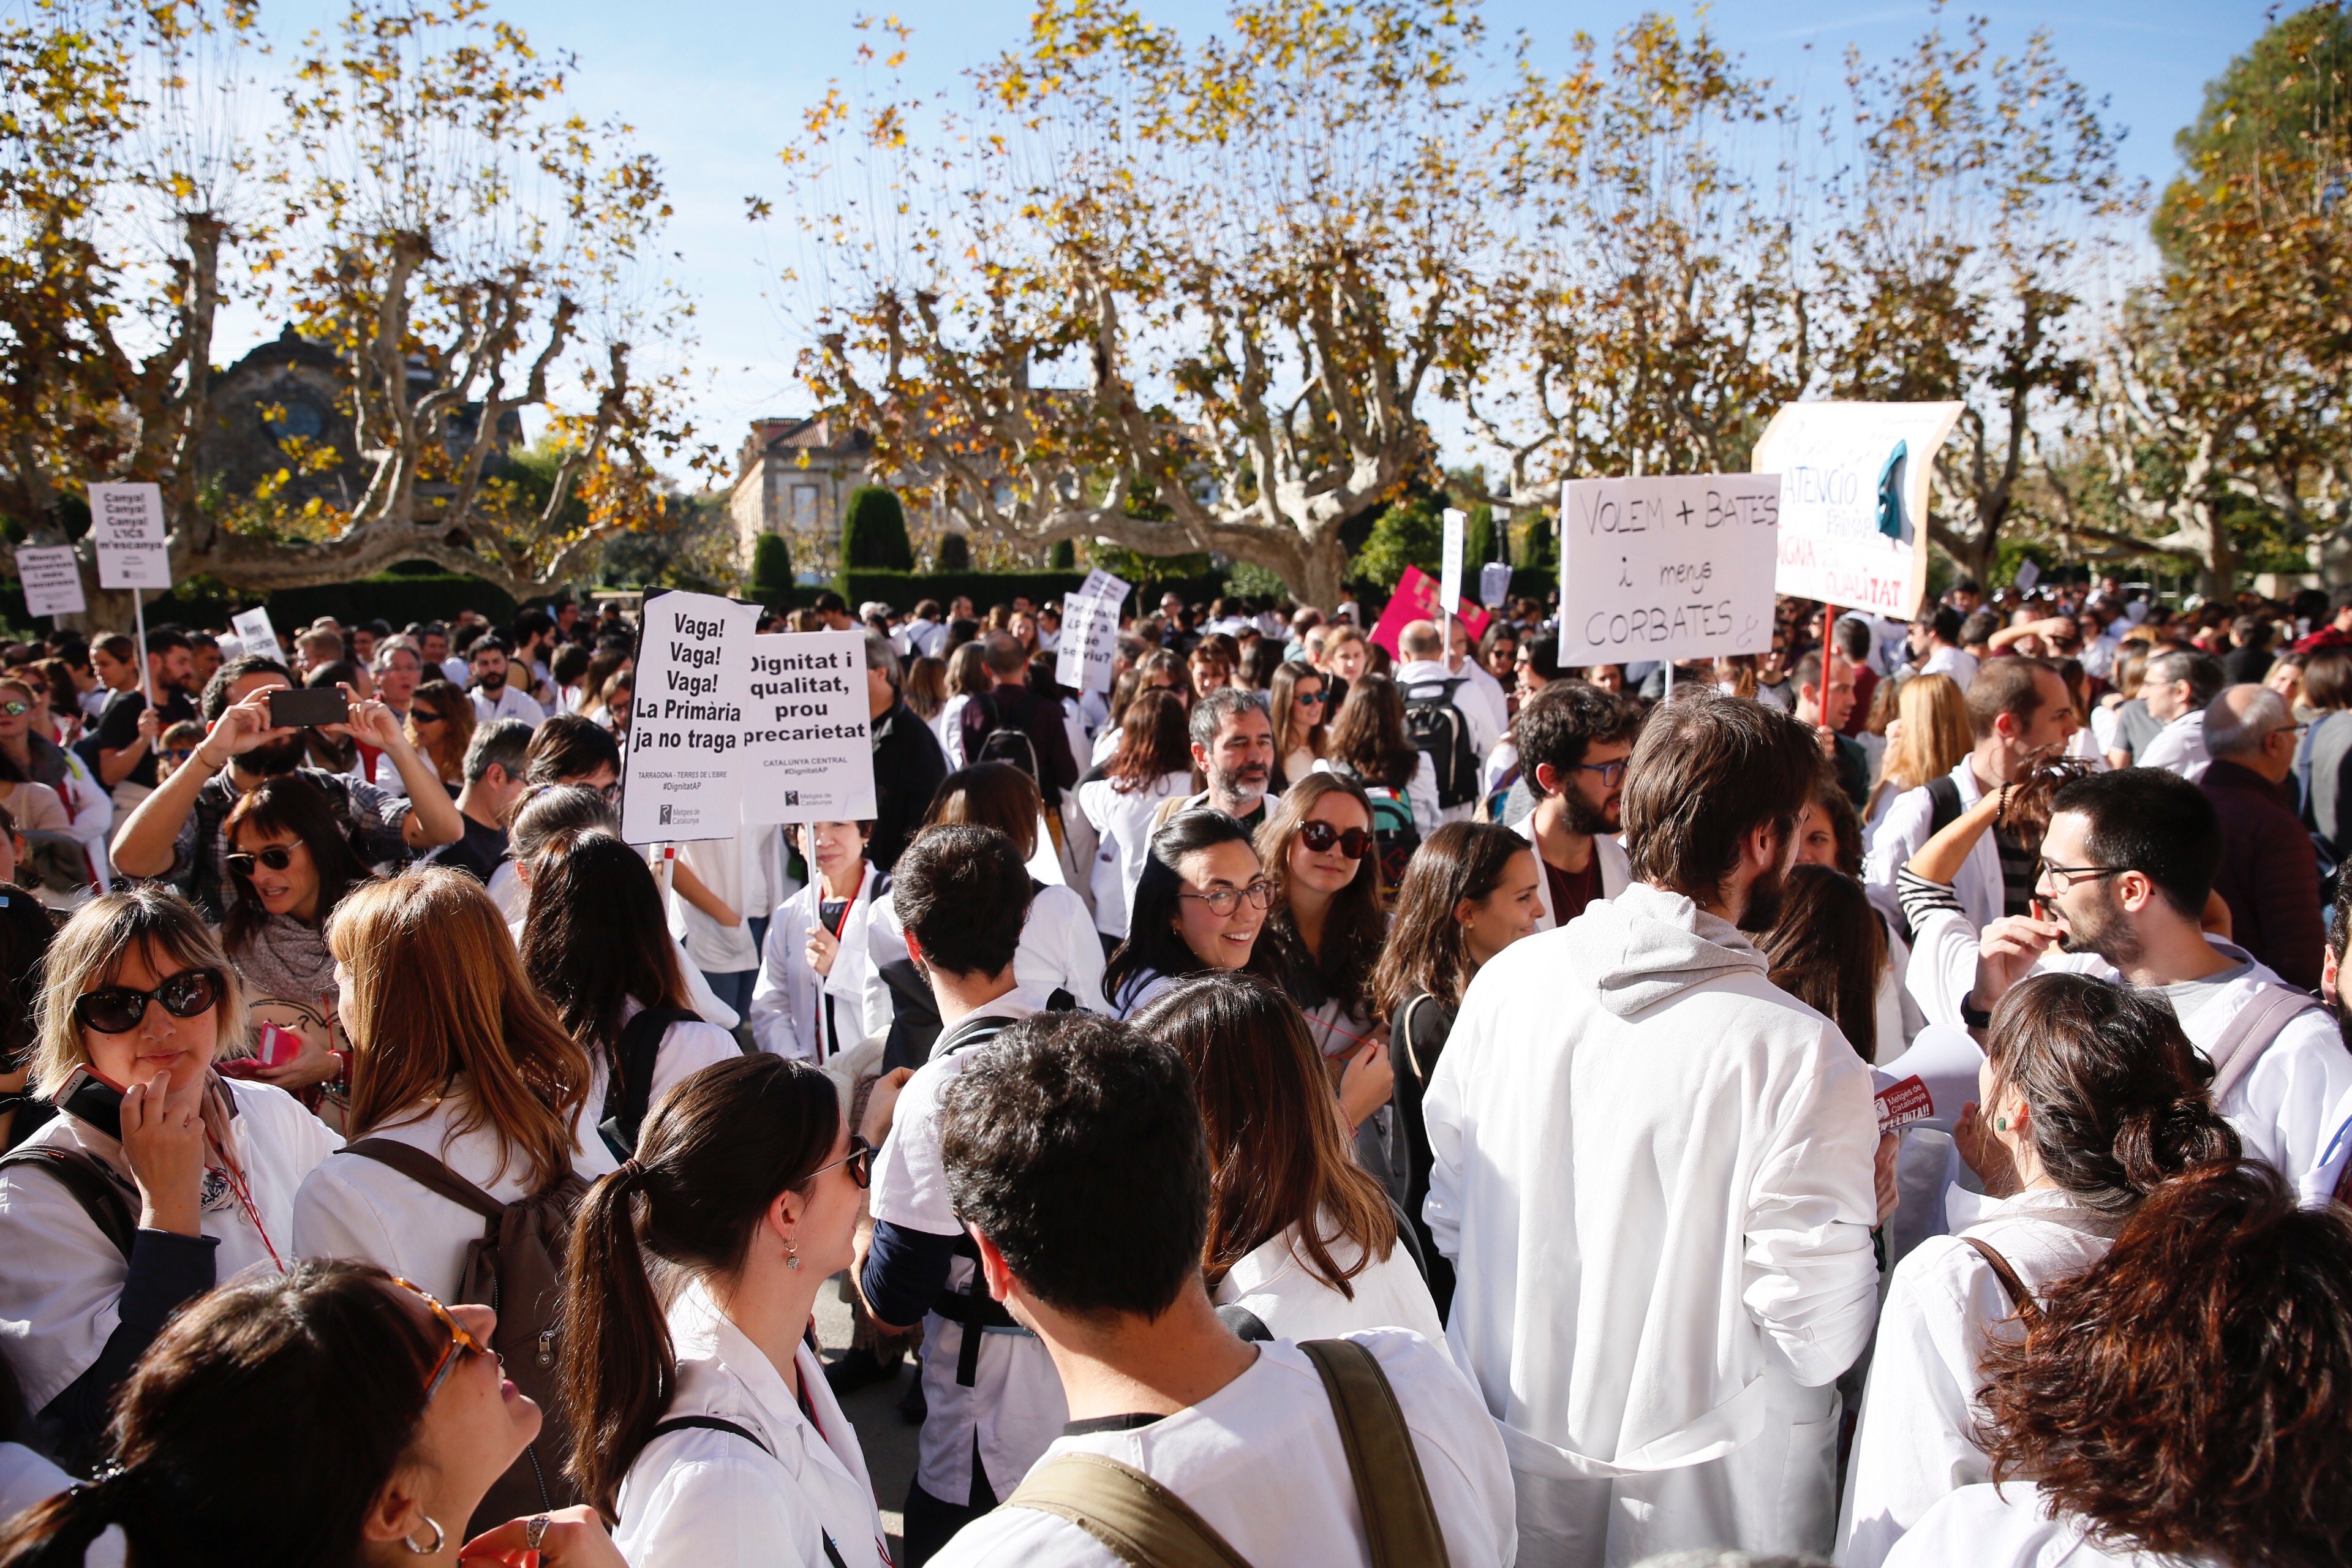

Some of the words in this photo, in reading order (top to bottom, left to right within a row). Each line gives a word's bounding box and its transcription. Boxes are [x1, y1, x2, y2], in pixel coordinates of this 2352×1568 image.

[1579, 491, 1665, 535] VOLEM
[1676, 501, 1694, 525] +
[1705, 491, 1778, 528] BATES
[1619, 556, 1633, 587] i
[1660, 562, 1712, 594] menys
[674, 612, 725, 641] Vaga!
[1585, 600, 1733, 646] CORBATES
[671, 642, 721, 668] Vaga!
[846, 652, 851, 667] i
[1063, 647, 1110, 664] seviu?
[667, 670, 718, 697] Vaga!
[750, 676, 849, 699] qualitat,
[636, 698, 658, 718] La
[665, 699, 741, 722] Primària
[775, 704, 828, 722] prou
[633, 727, 652, 753] ja
[658, 732, 681, 748] no
[688, 729, 736, 753] traga
[744, 723, 865, 747] precarietat
[763, 758, 810, 767] CATALUNYA
[784, 767, 828, 775] #DignitatAP
[663, 782, 701, 792] #DignitatAP
[1887, 1090, 1913, 1106] Metges
[1891, 1093, 1926, 1114] Catalunya
